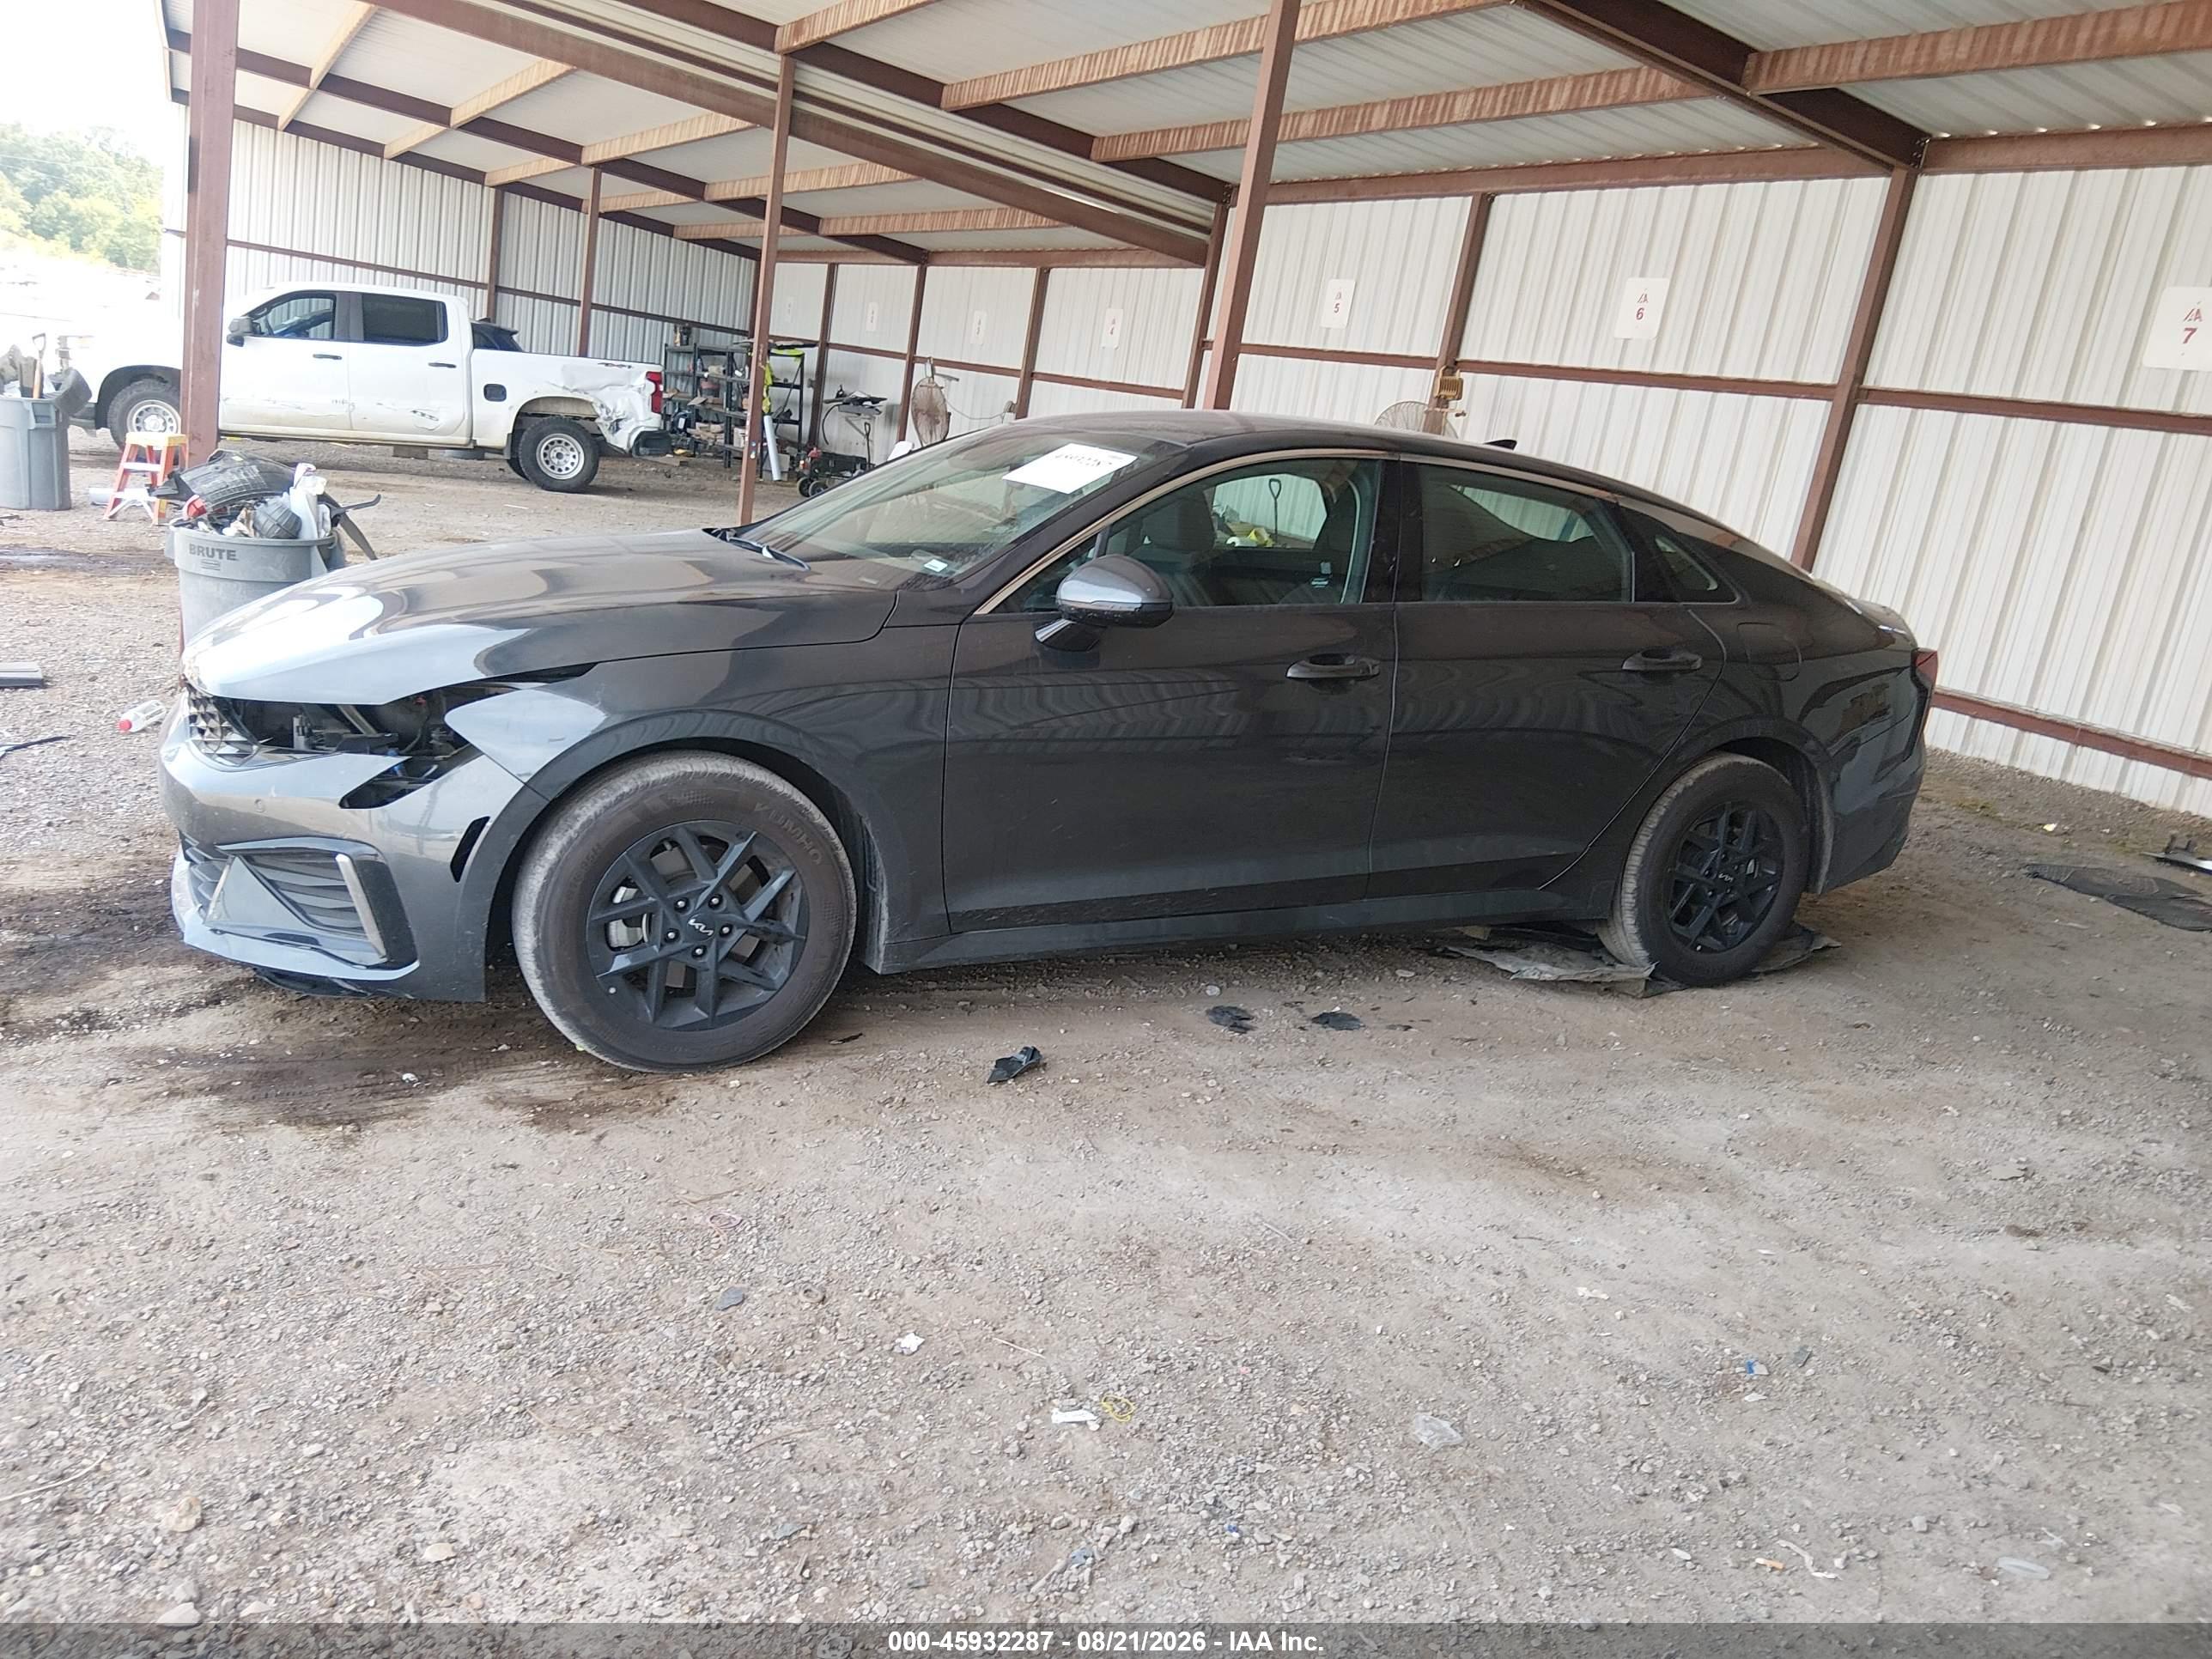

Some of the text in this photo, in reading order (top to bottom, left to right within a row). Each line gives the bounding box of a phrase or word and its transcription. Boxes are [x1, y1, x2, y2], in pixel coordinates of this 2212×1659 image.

[1636, 307, 1645, 321] 6
[2182, 326, 2198, 344] 7
[189, 543, 238, 561] BRUTE
